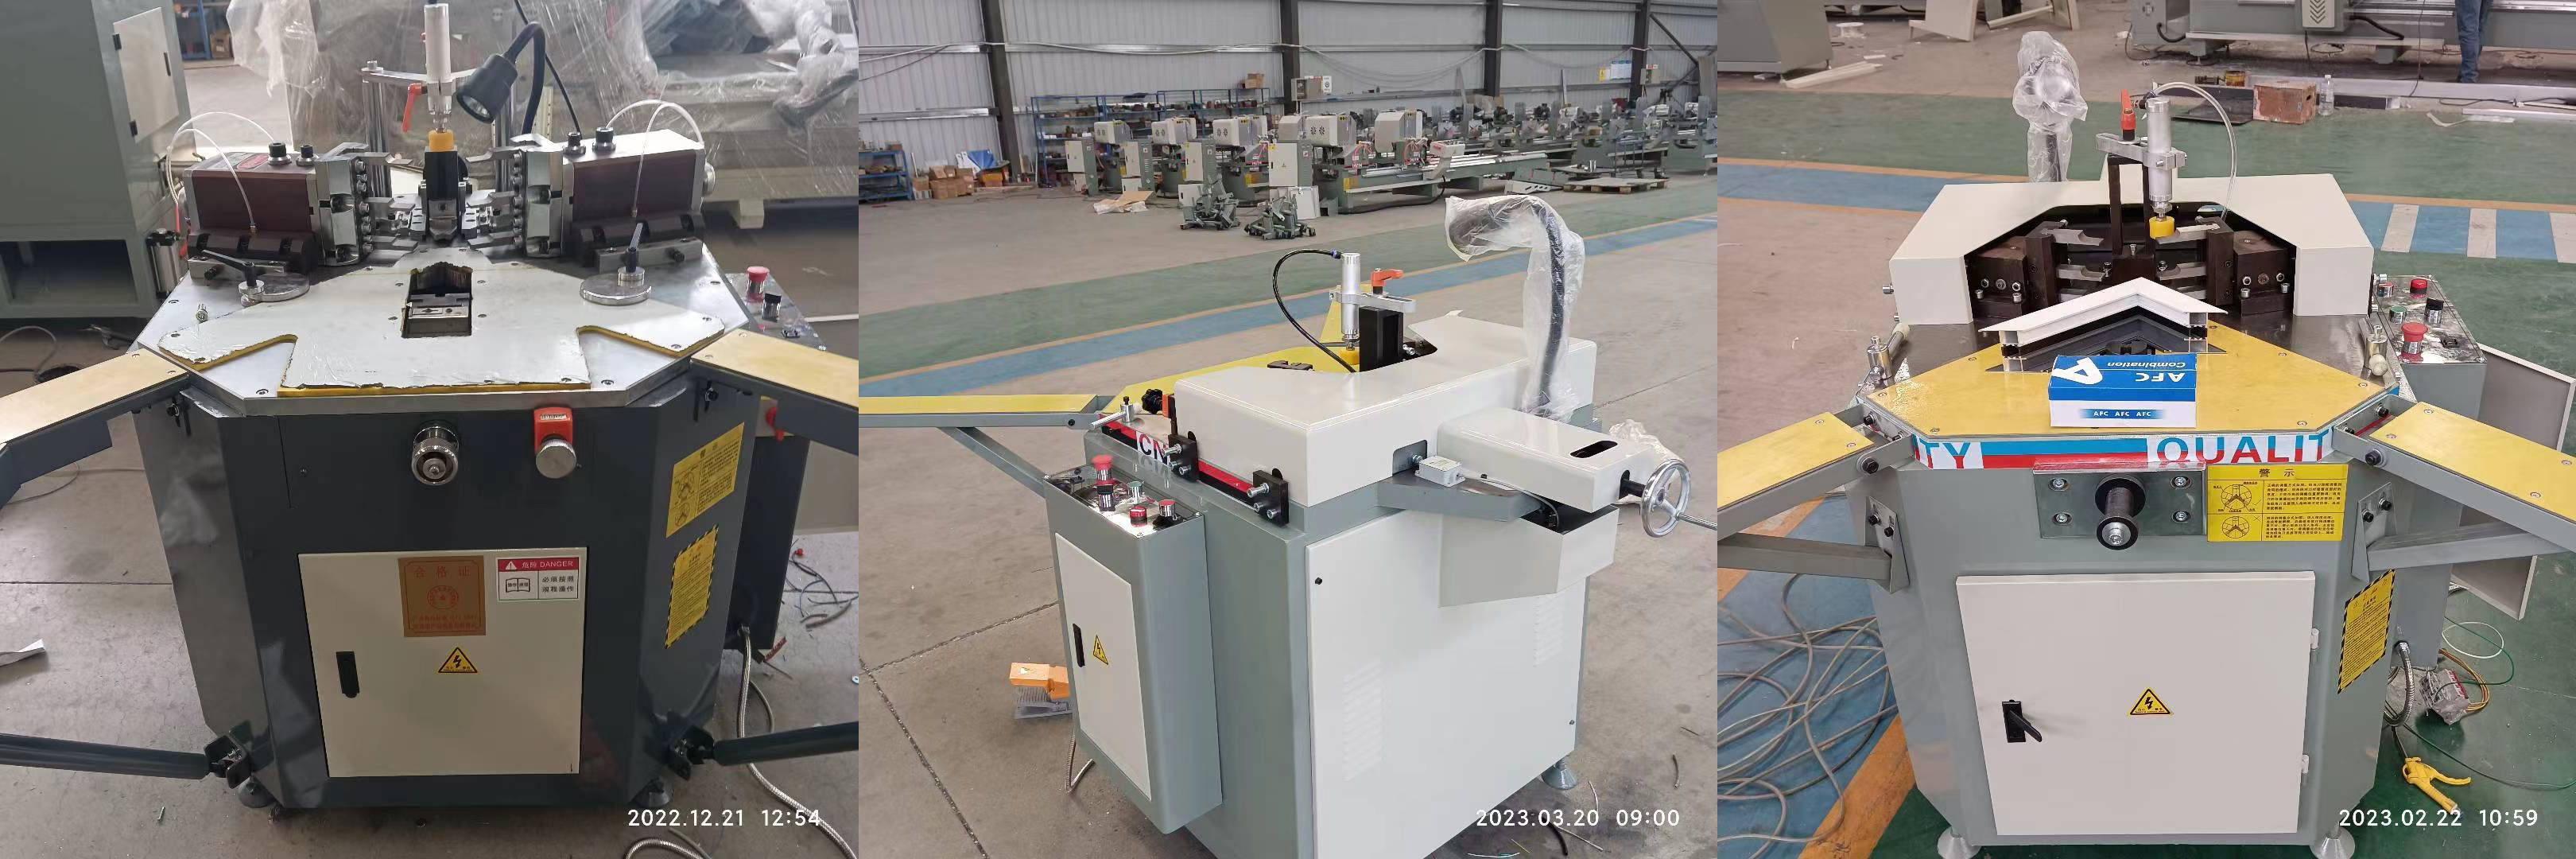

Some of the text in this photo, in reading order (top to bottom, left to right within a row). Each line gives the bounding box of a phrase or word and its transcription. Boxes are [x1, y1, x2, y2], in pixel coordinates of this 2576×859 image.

[2135, 372, 2186, 383] AFC
[2157, 427, 2334, 464] QUALIT
[2259, 468, 2295, 477] 警示
